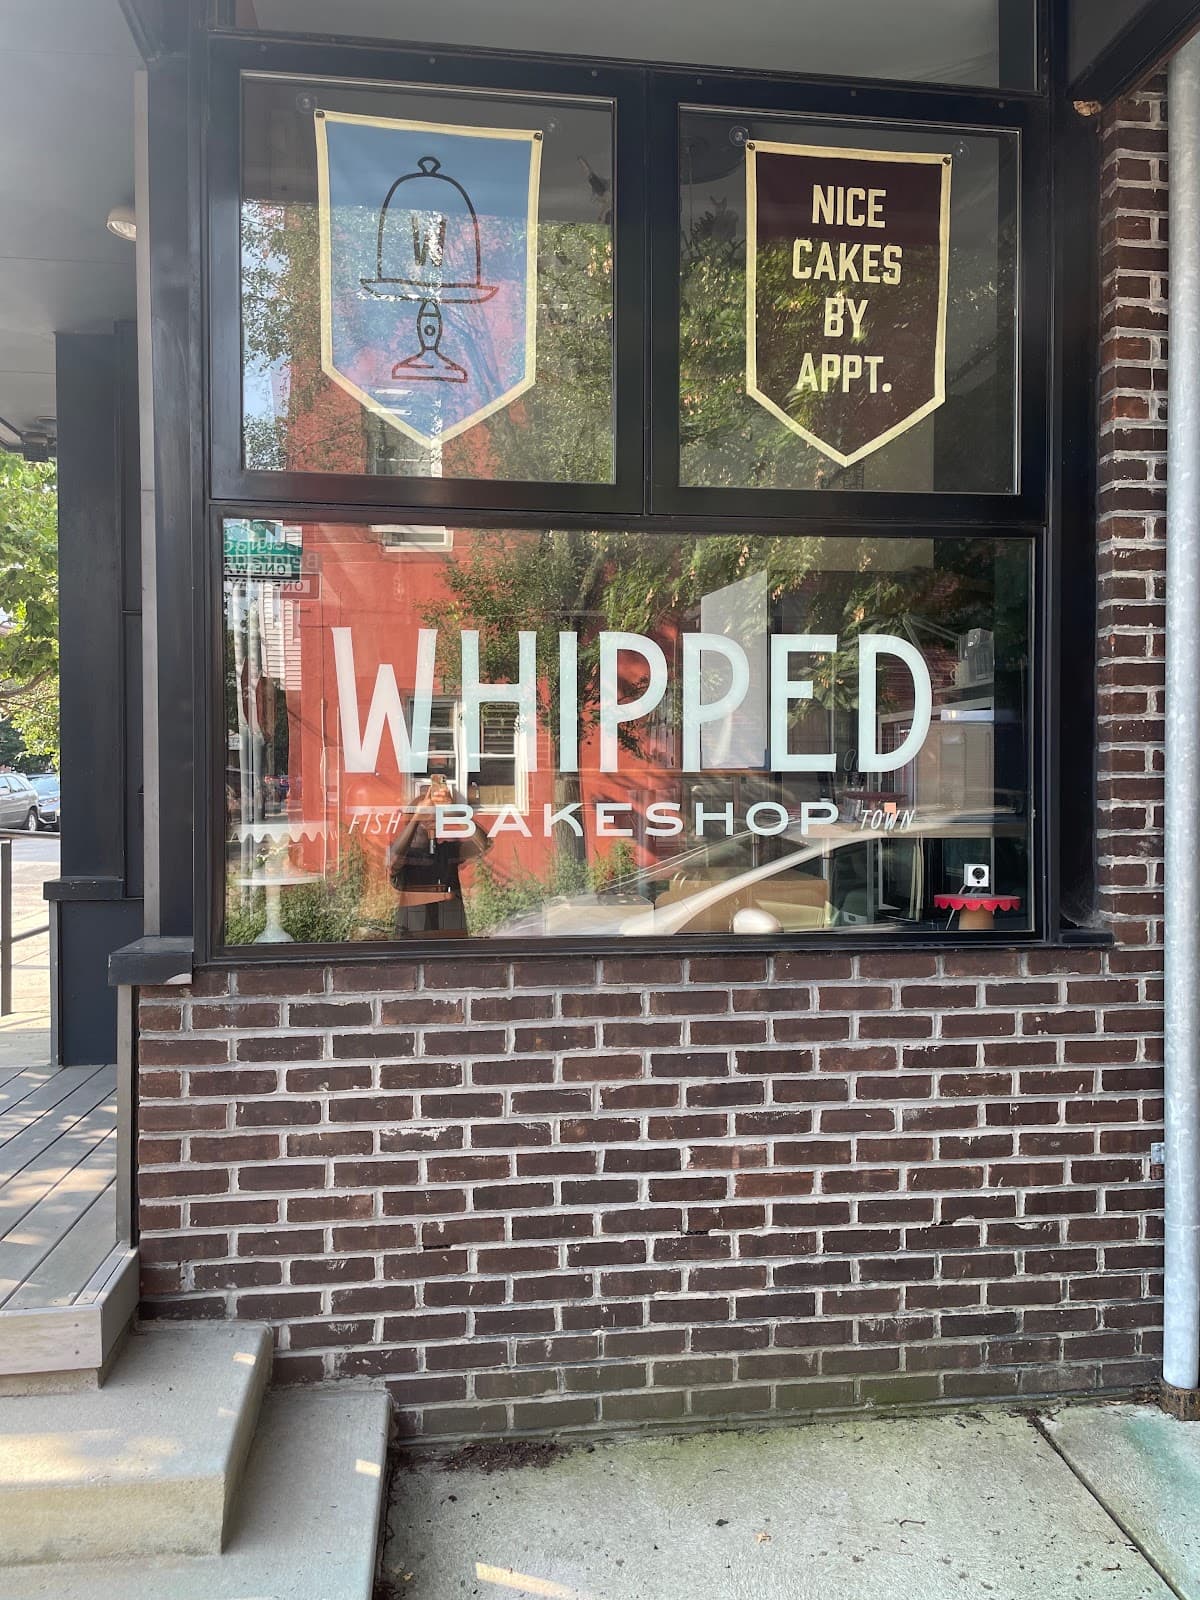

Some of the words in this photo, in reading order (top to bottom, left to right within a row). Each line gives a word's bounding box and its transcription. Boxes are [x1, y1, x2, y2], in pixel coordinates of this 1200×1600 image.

[811, 184, 887, 229] NICE
[791, 238, 903, 286] CAKES
[823, 297, 869, 338] BY
[795, 352, 893, 394] APPT.
[331, 626, 933, 774] WHIPPED
[348, 812, 402, 835] FISH
[435, 802, 840, 839] BAKESHOP
[860, 809, 916, 831] TOWN
